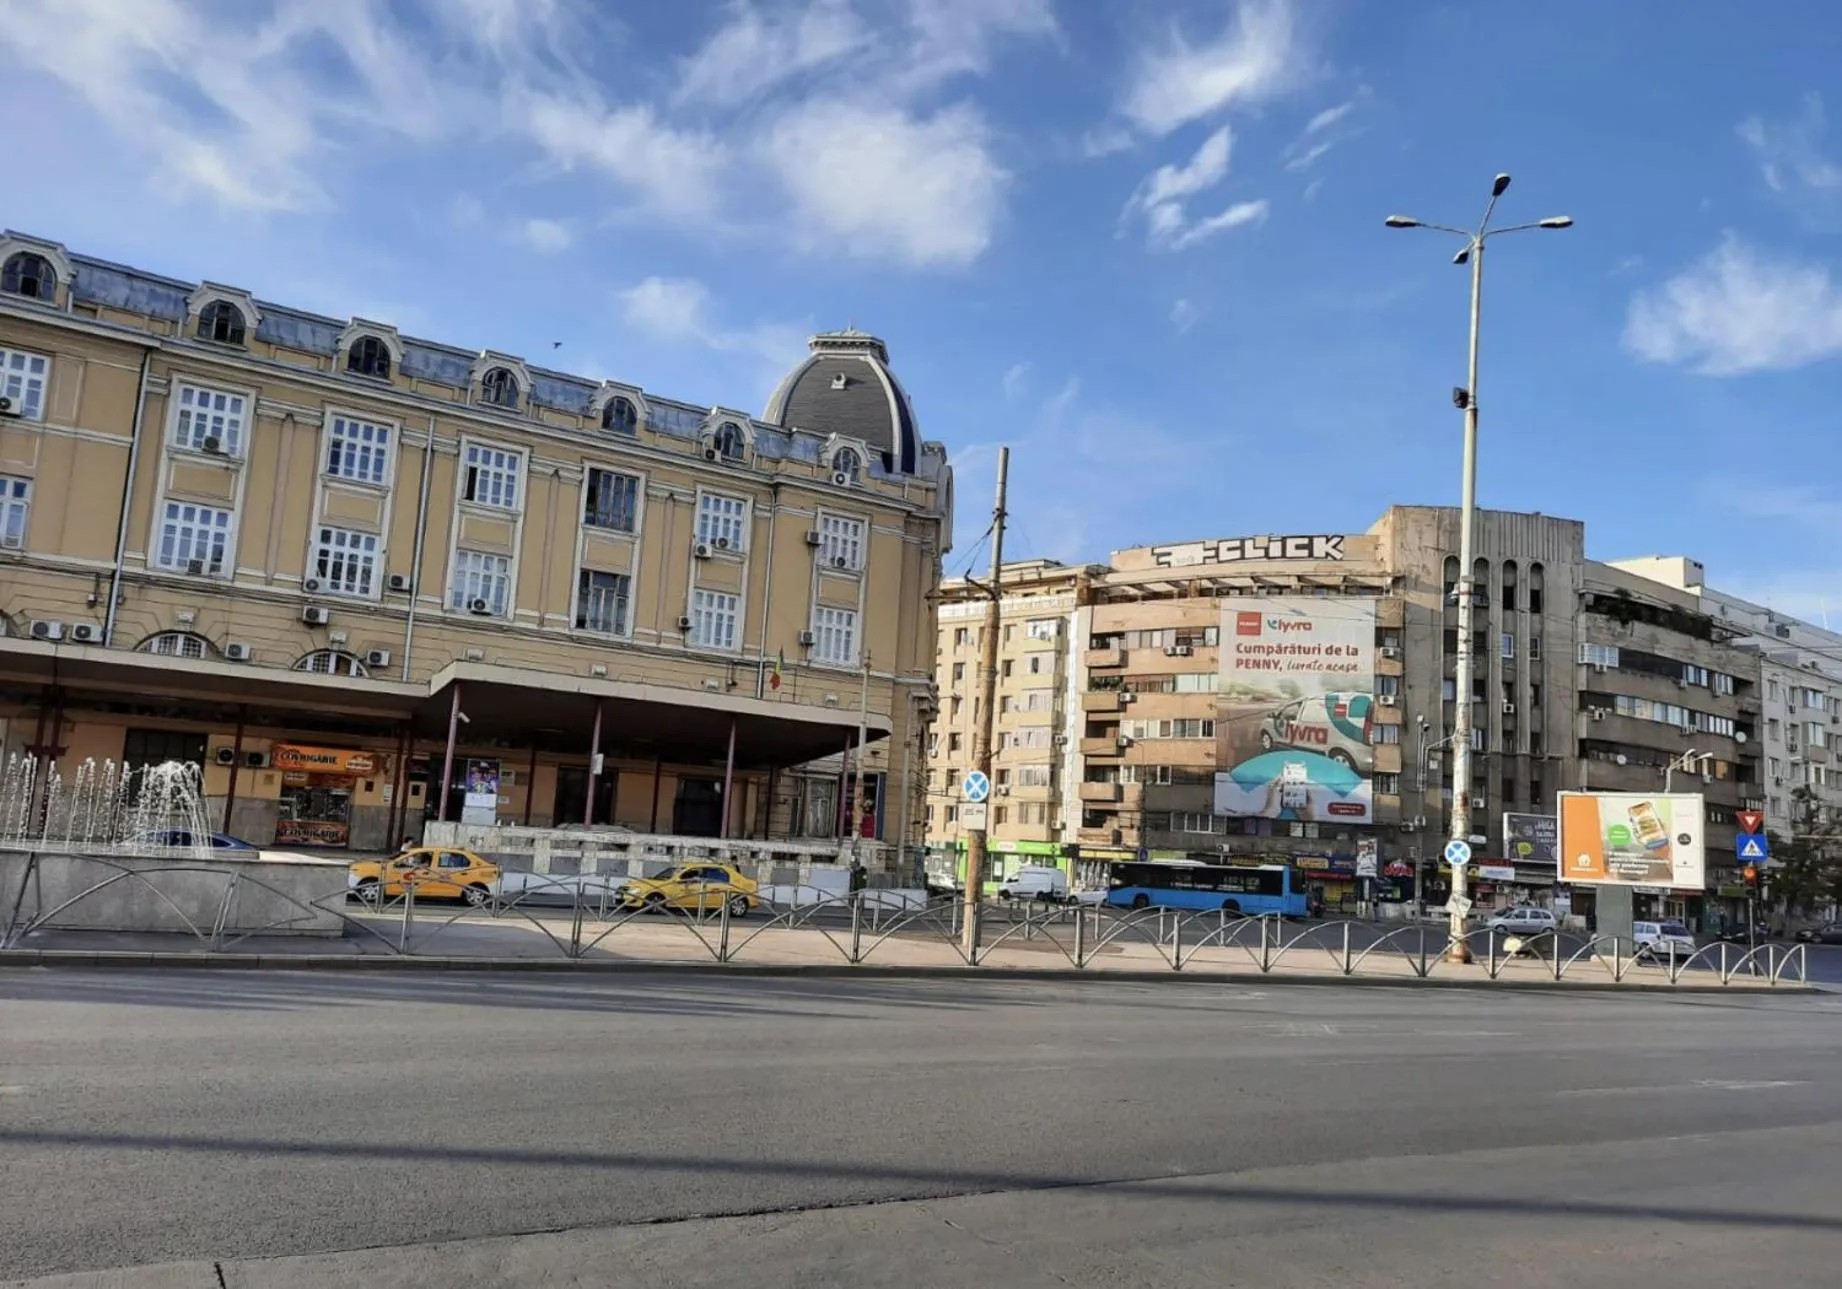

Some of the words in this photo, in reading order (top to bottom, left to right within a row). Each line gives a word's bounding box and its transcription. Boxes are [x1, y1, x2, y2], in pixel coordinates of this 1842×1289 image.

[1278, 619, 1312, 633] lyvra
[1325, 645, 1342, 656] de
[1346, 645, 1359, 657] la
[1236, 658, 1283, 672] PENNY,
[1285, 722, 1328, 745] lyvra
